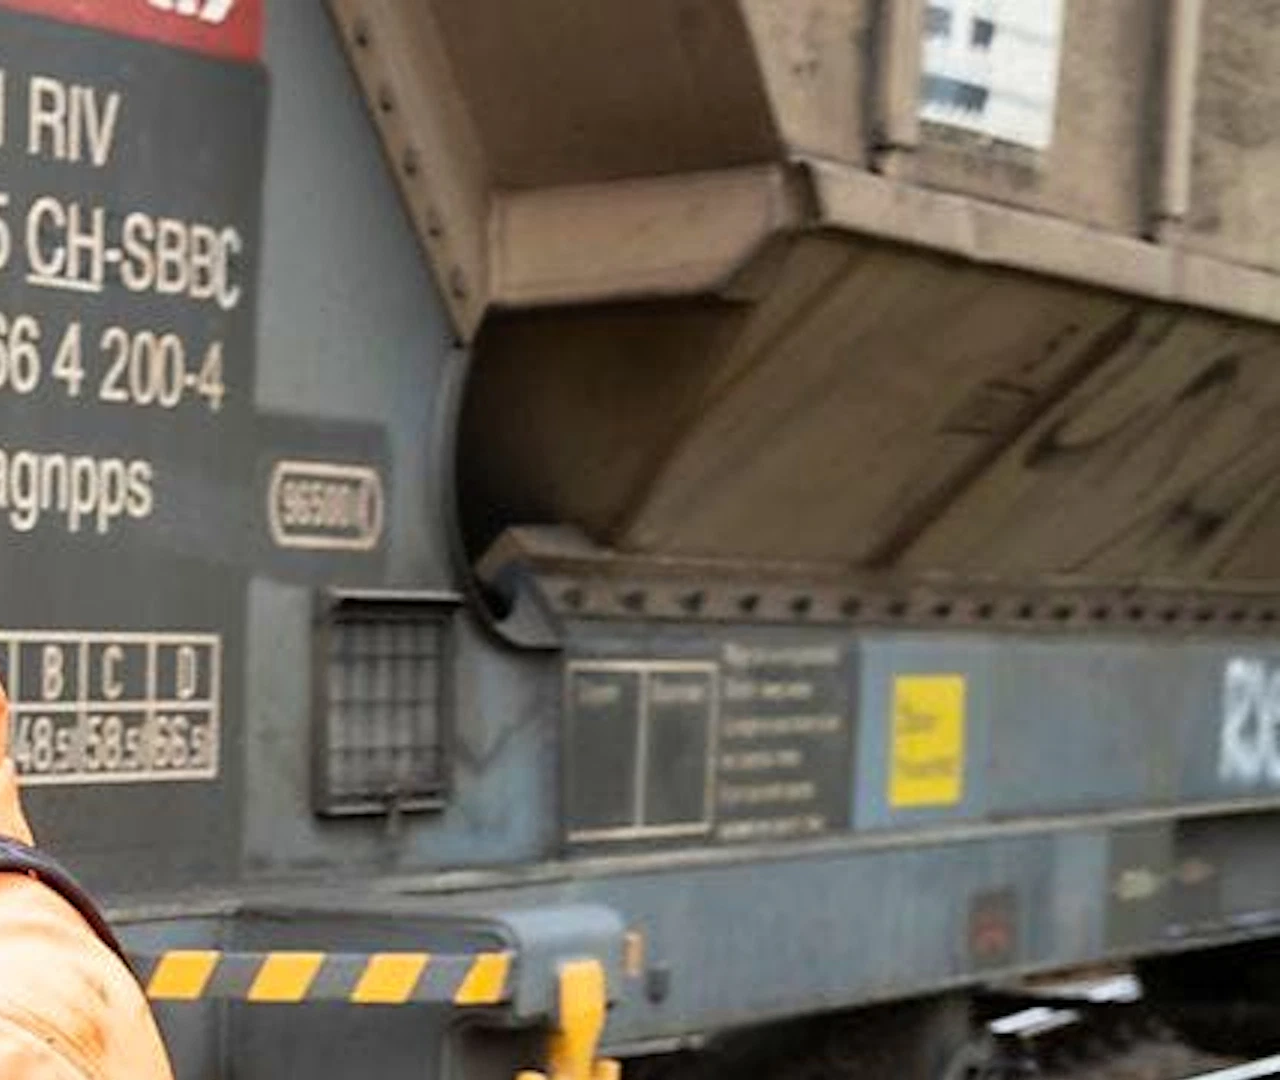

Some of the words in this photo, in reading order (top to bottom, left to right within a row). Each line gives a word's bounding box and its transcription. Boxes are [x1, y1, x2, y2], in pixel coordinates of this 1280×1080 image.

[26, 75, 121, 167] RIV
[25, 196, 242, 311] CH-SBBC
[51, 322, 85, 397] 4
[98, 326, 226, 412] 200-4
[42, 644, 64, 701] B
[101, 644, 124, 700] C
[175, 645, 198, 700] D
